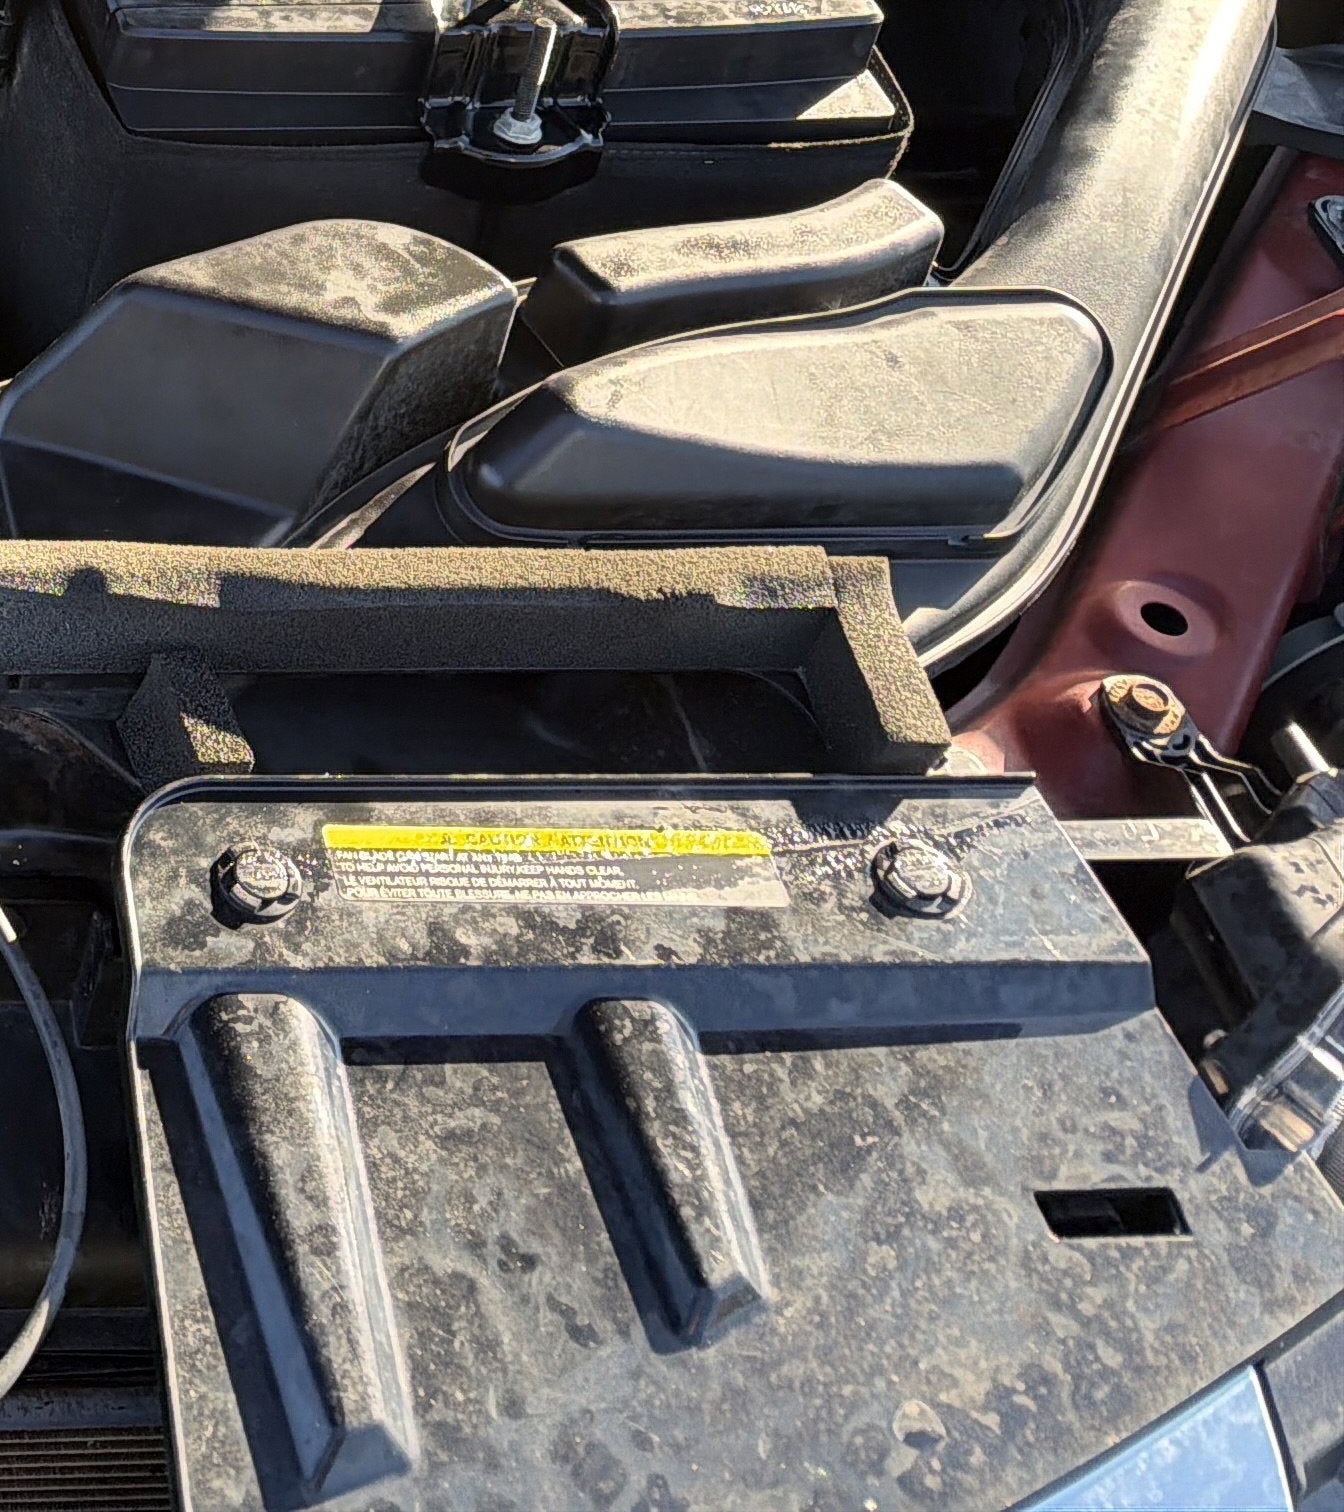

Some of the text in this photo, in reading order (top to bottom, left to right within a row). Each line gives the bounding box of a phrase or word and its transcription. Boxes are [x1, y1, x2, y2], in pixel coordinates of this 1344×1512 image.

[340, 862, 355, 871] TO
[357, 862, 384, 872] HELP
[386, 862, 419, 873] AVOID
[421, 863, 479, 874] PERSONAL
[546, 865, 584, 876] HANDS
[343, 875, 358, 886] LE
[359, 876, 428, 887] VENTILATEUR
[429, 876, 471, 888] RISQUE
[472, 877, 487, 888] DE
[559, 878, 587, 888] TOUT
[418, 889, 455, 899] TOUTE
